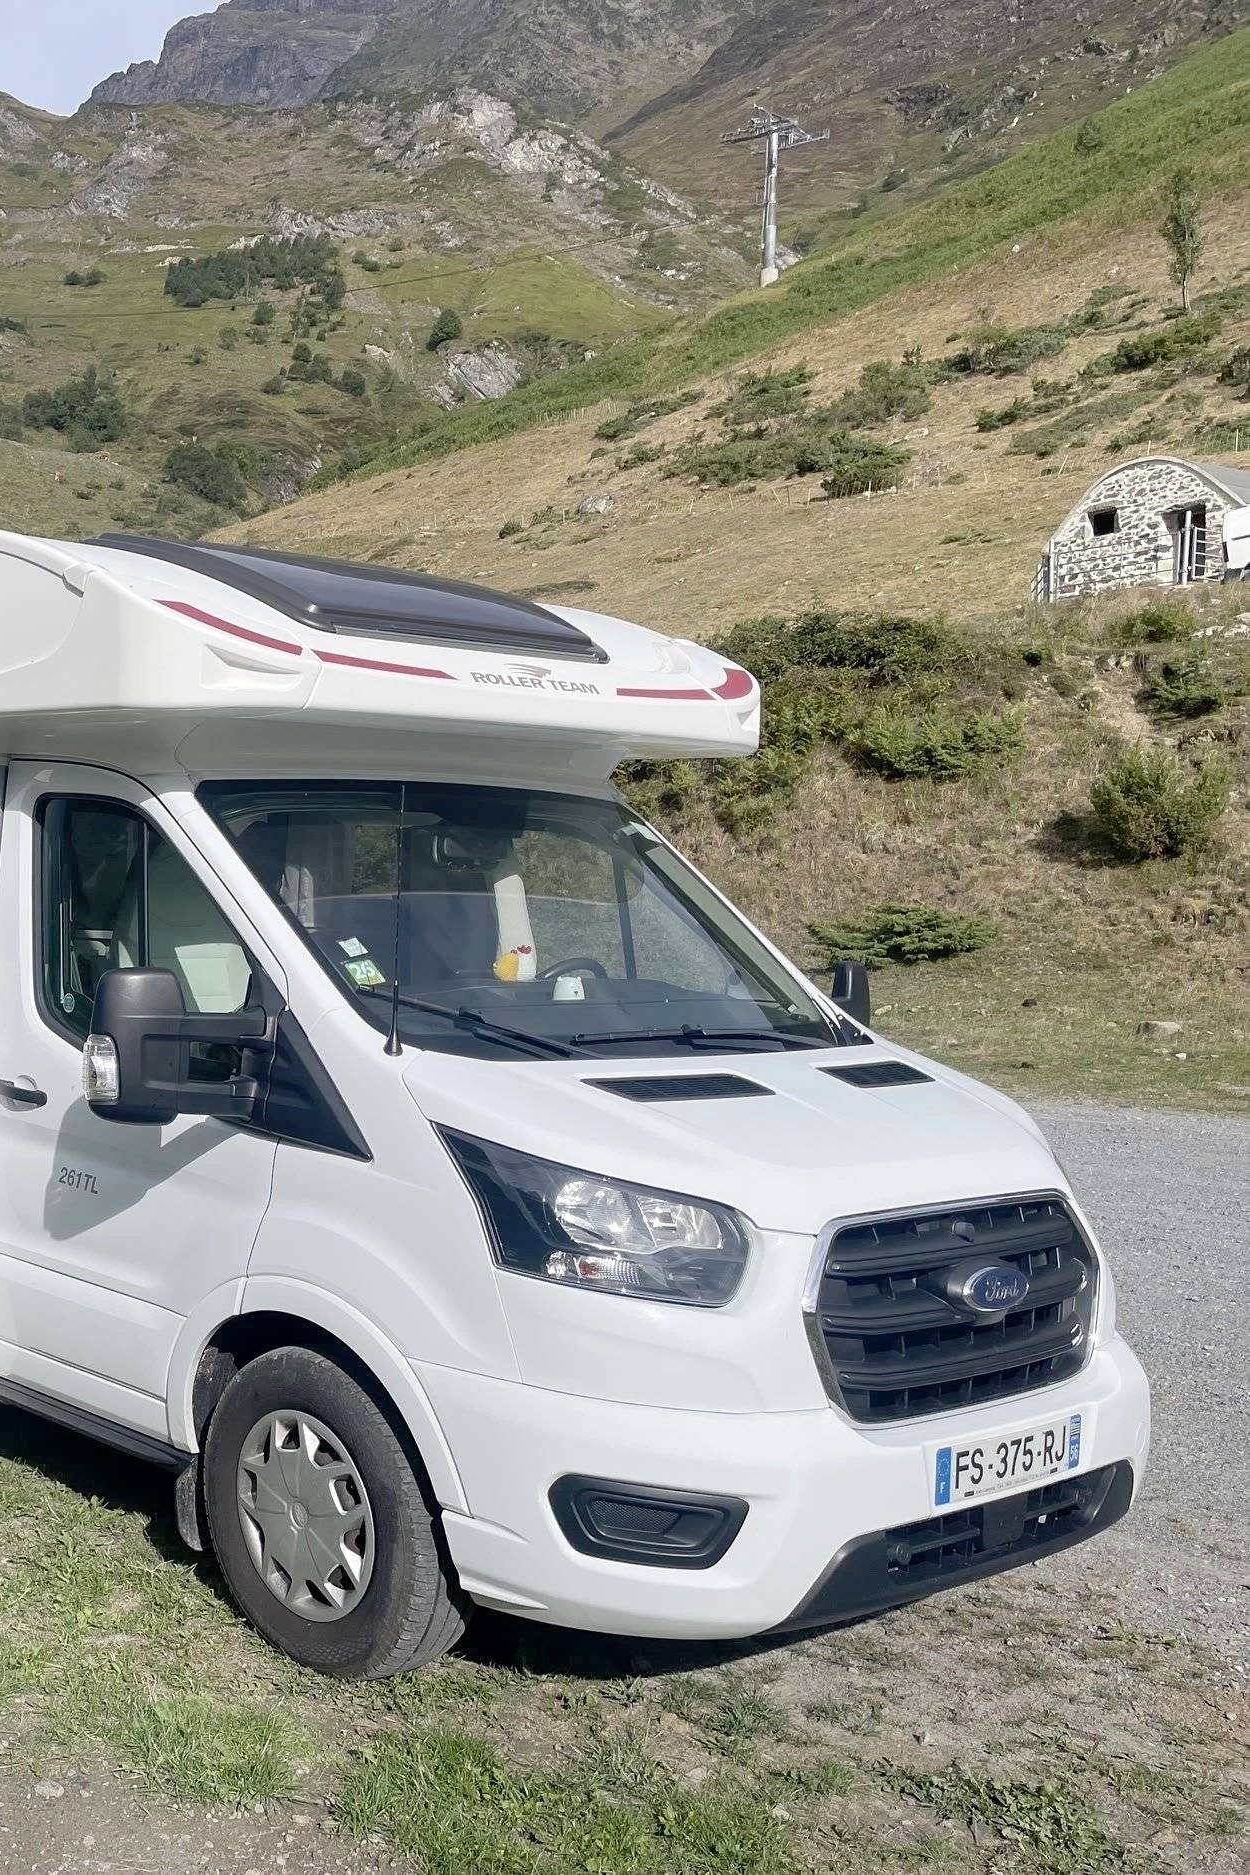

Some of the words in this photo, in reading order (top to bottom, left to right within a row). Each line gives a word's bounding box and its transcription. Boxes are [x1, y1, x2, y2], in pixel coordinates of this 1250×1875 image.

[470, 671, 546, 689] ROLLER
[547, 680, 600, 695] TEAM
[59, 1167, 98, 1194] 261TL
[985, 1276, 1019, 1301] Ford
[955, 1425, 1066, 1489] FS-375-RJ
[939, 1482, 946, 1494] F
